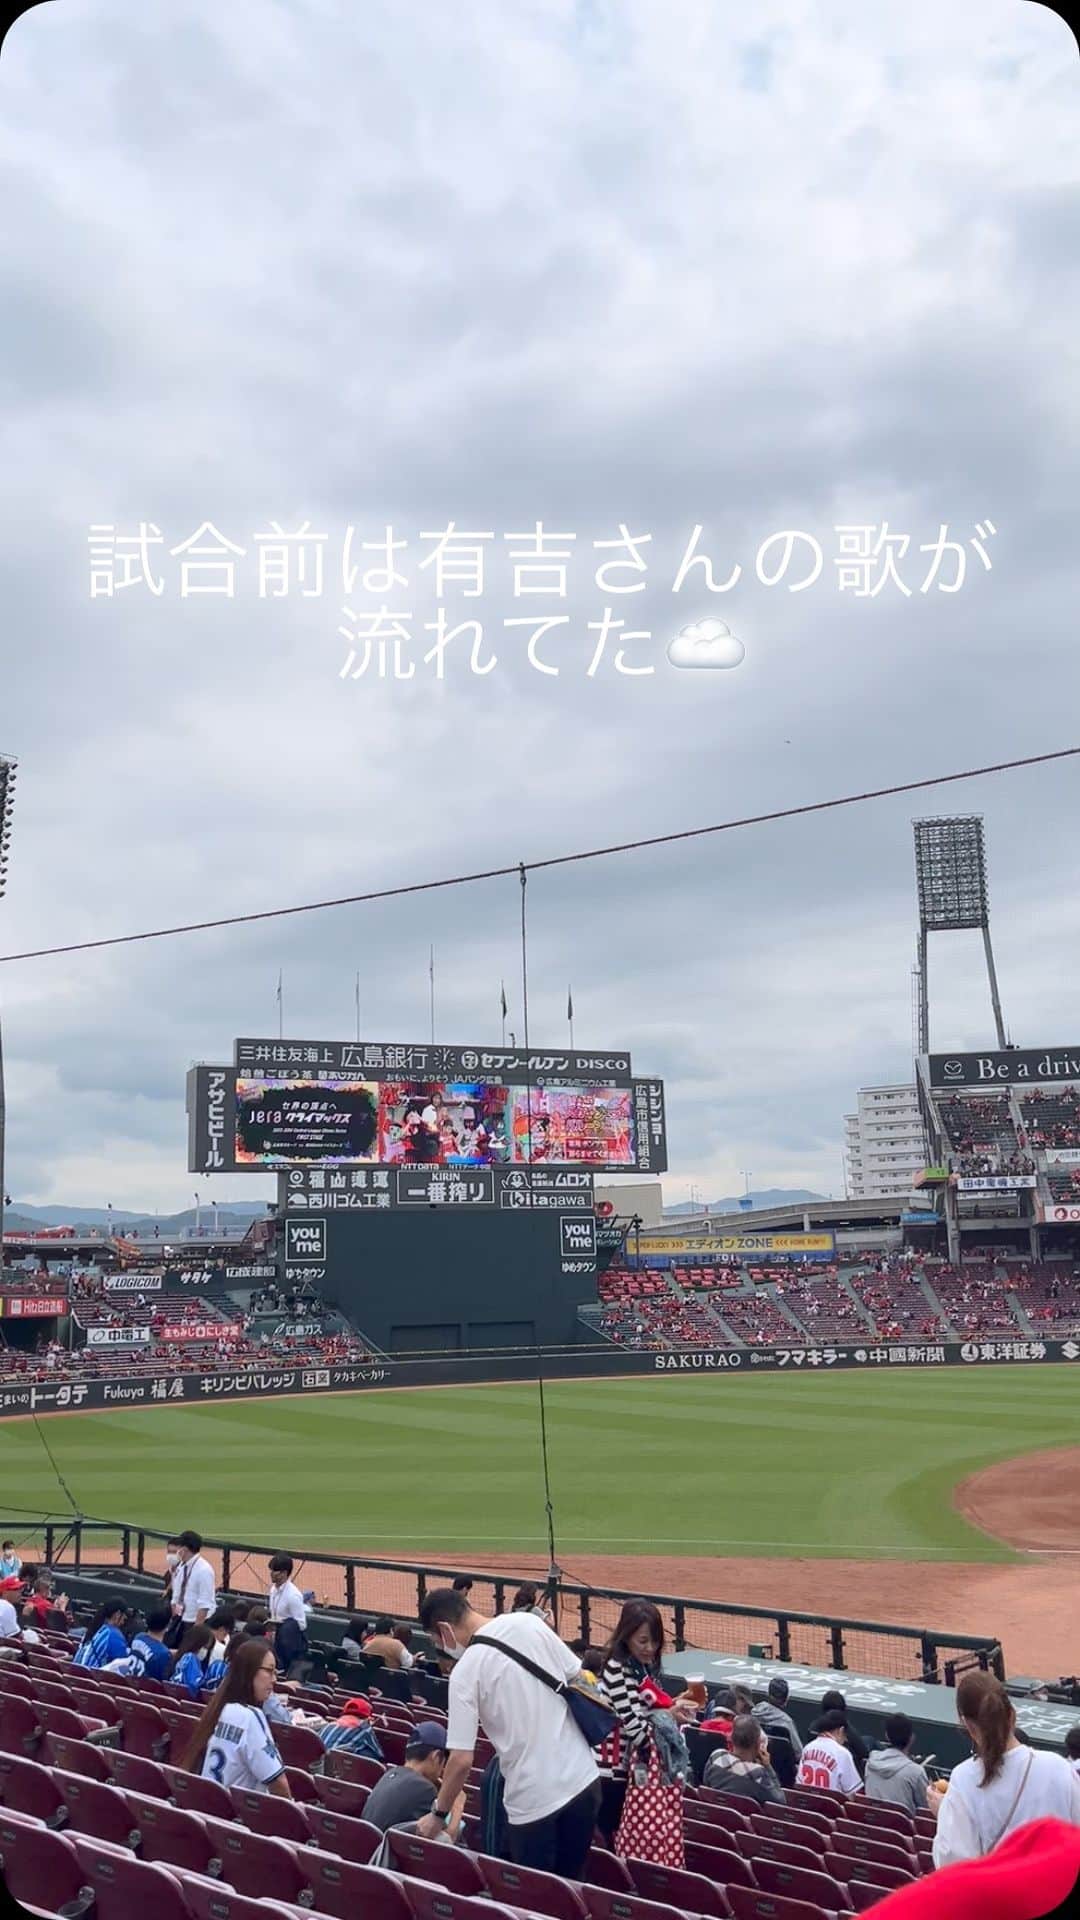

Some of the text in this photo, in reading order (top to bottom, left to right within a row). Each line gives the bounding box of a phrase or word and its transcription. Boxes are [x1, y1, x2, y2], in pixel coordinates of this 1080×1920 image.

[239, 1045, 334, 1064] 三井住友海上
[340, 1045, 429, 1070] 広島銀行
[576, 1058, 628, 1071] DISCO
[977, 1058, 1010, 1080] Be
[1017, 1062, 1031, 1078] a
[205, 1072, 226, 1168] アサヒビール
[285, 1112, 352, 1124] クライマックス
[636, 1084, 652, 1169] 広島市信用組合
[309, 1170, 390, 1189] 福山通運
[432, 1172, 461, 1182] KIRIN
[555, 1173, 591, 1187] ムロオ
[408, 1182, 484, 1202] 一番搾り
[308, 1193, 391, 1209] 西川ゴム工業
[290, 1227, 320, 1243] you
[564, 1224, 590, 1239] you
[296, 1241, 322, 1253] me
[570, 1237, 592, 1248] me
[686, 1238, 735, 1249] エディオン
[737, 1237, 774, 1249] ZONE
[561, 1262, 597, 1273] ゆめタウン
[115, 1276, 160, 1289] LOGICOM
[180, 1271, 212, 1285] サタケ
[108, 1328, 145, 1342] 中電工
[285, 1324, 323, 1336] 広島ガス
[775, 1349, 847, 1366] フマキラー
[869, 1346, 945, 1363] 中國新聞
[980, 1342, 1047, 1360] 東洋証券
[655, 1353, 741, 1369] SAKURAO
[200, 1372, 296, 1393] キリンビバレッジ
[333, 1369, 392, 1383] タカキベーカリー
[31, 1384, 89, 1409] トータテ
[104, 1378, 185, 1400] Fukuya 福屋
